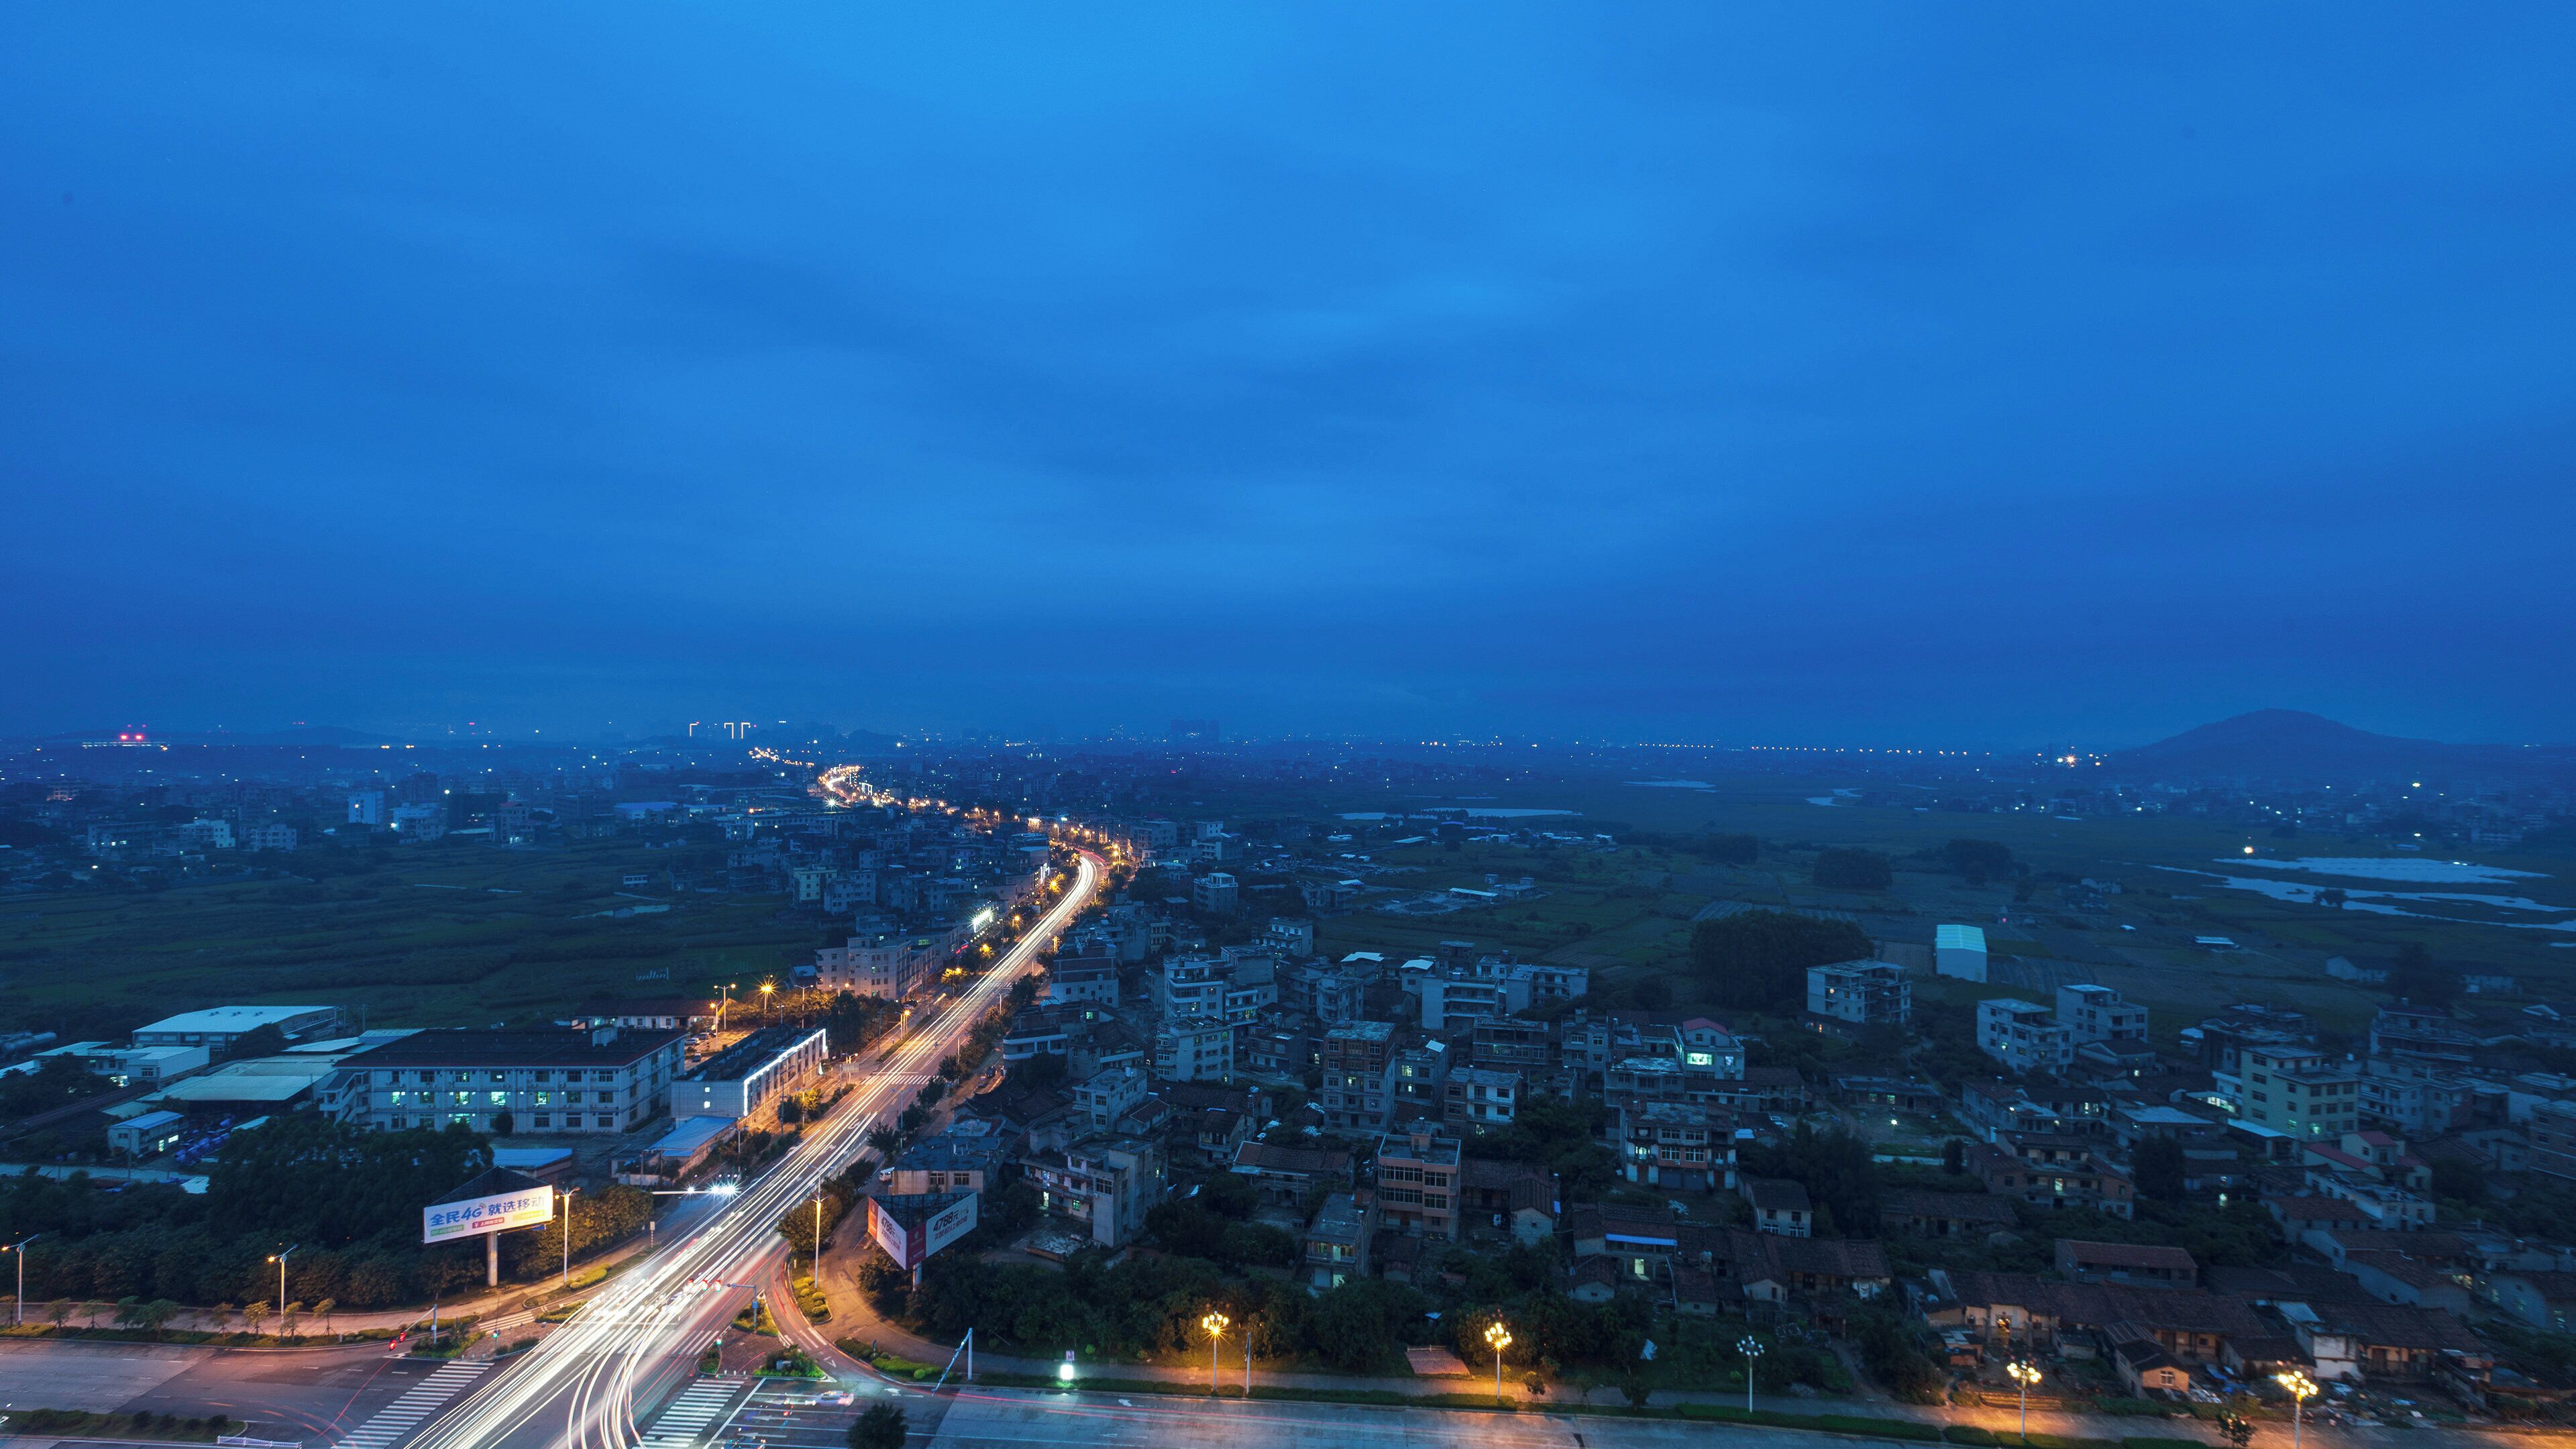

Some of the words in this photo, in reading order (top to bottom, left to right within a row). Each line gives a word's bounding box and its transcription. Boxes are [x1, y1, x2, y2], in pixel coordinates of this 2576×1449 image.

[430, 1207, 482, 1226] 全民4G
[488, 1196, 544, 1216] 就选移动
